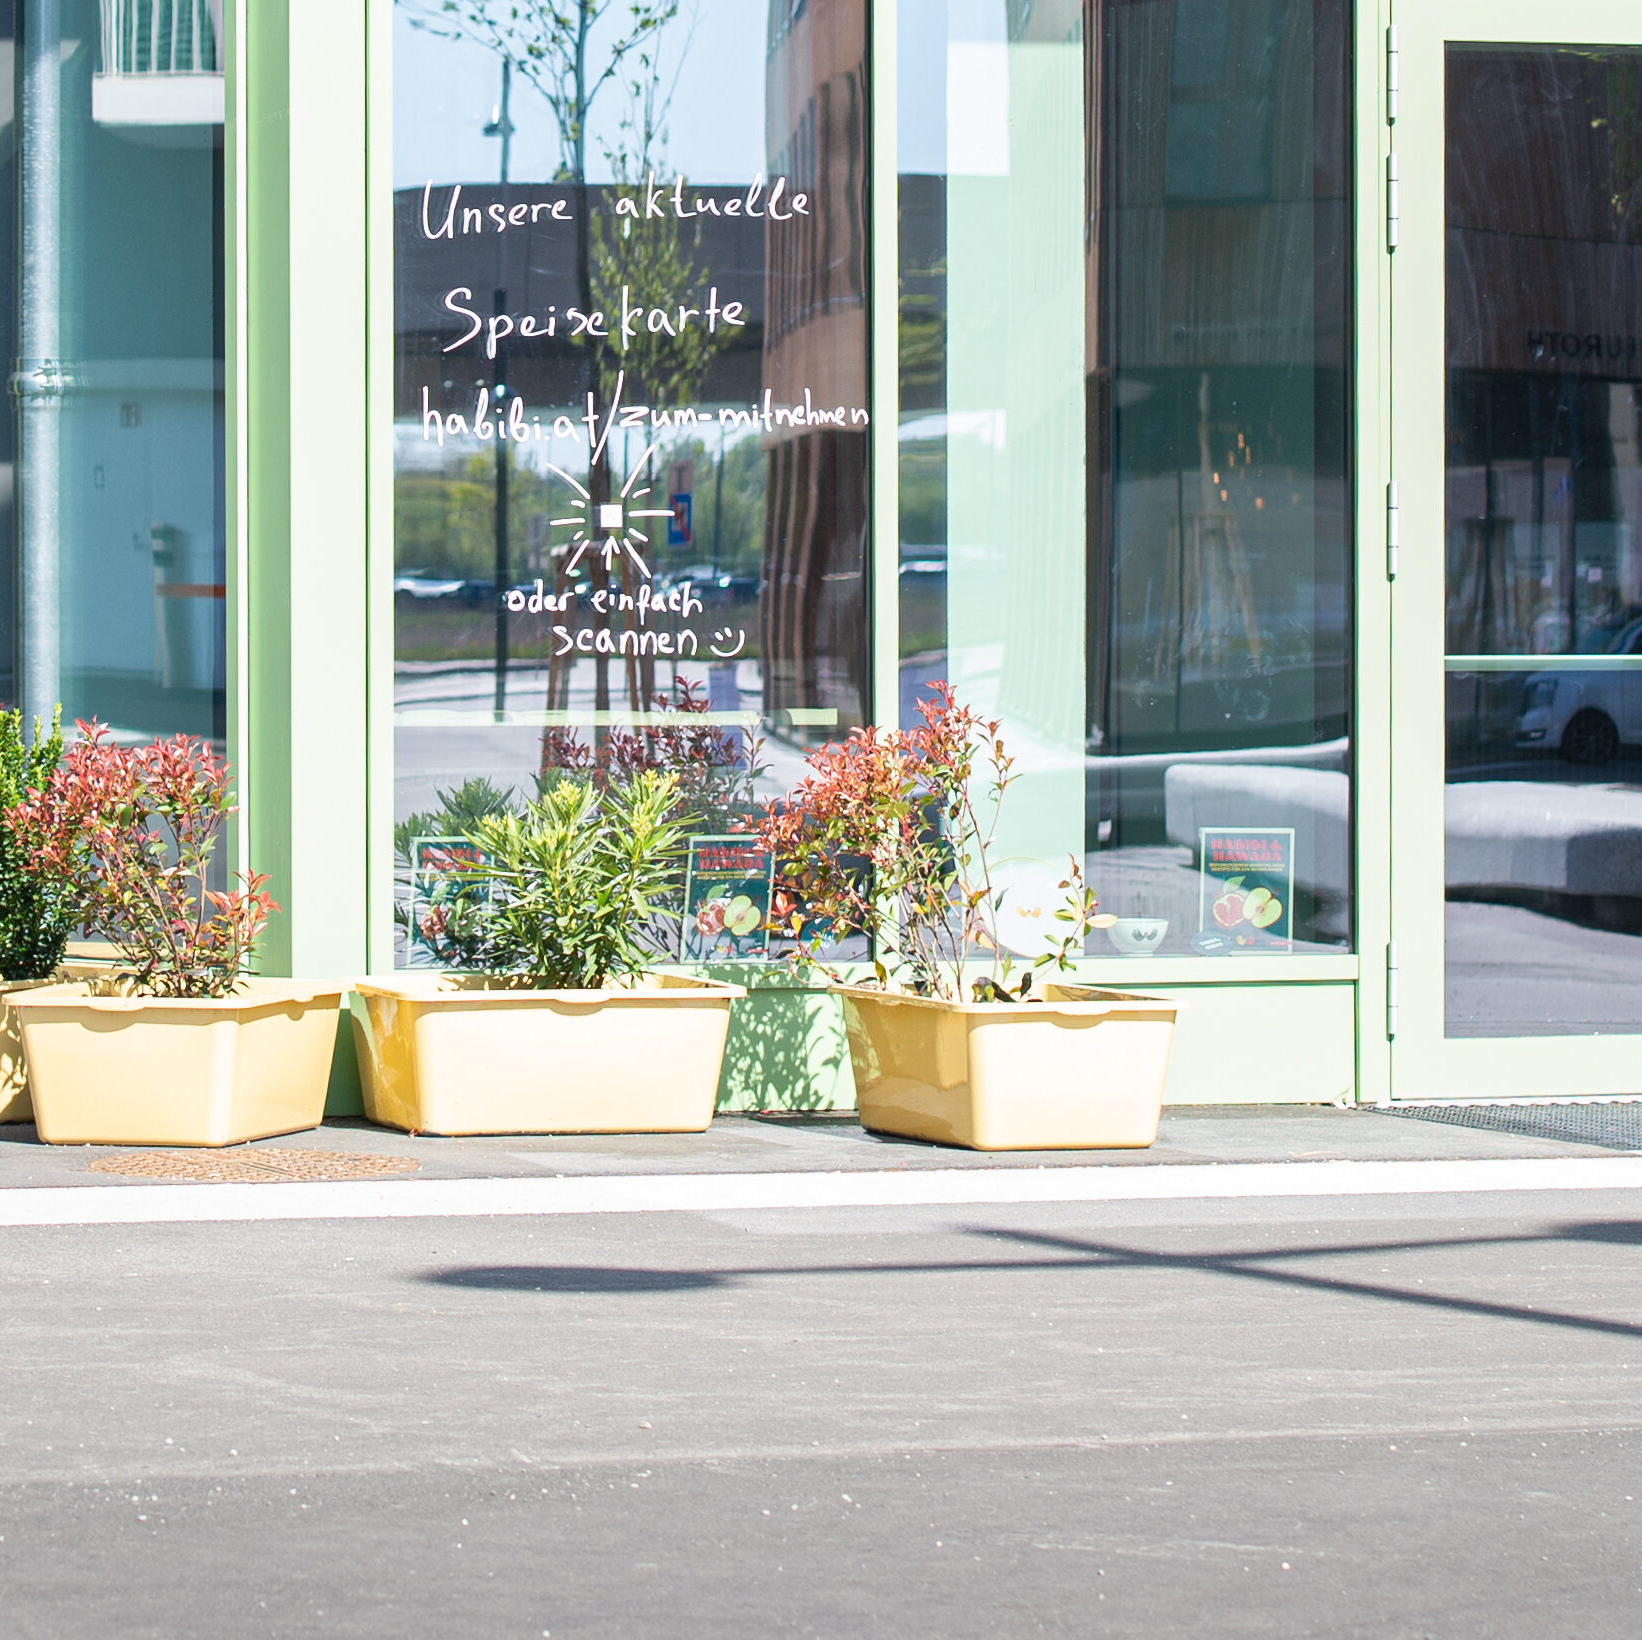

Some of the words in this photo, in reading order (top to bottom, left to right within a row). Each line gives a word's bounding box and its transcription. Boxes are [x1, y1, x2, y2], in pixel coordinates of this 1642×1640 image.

[421, 178, 574, 240] Unsere
[615, 171, 811, 221] aktuelle
[508, 580, 574, 614] oder
[591, 581, 703, 624] einfach
[553, 625, 698, 656] scannen
